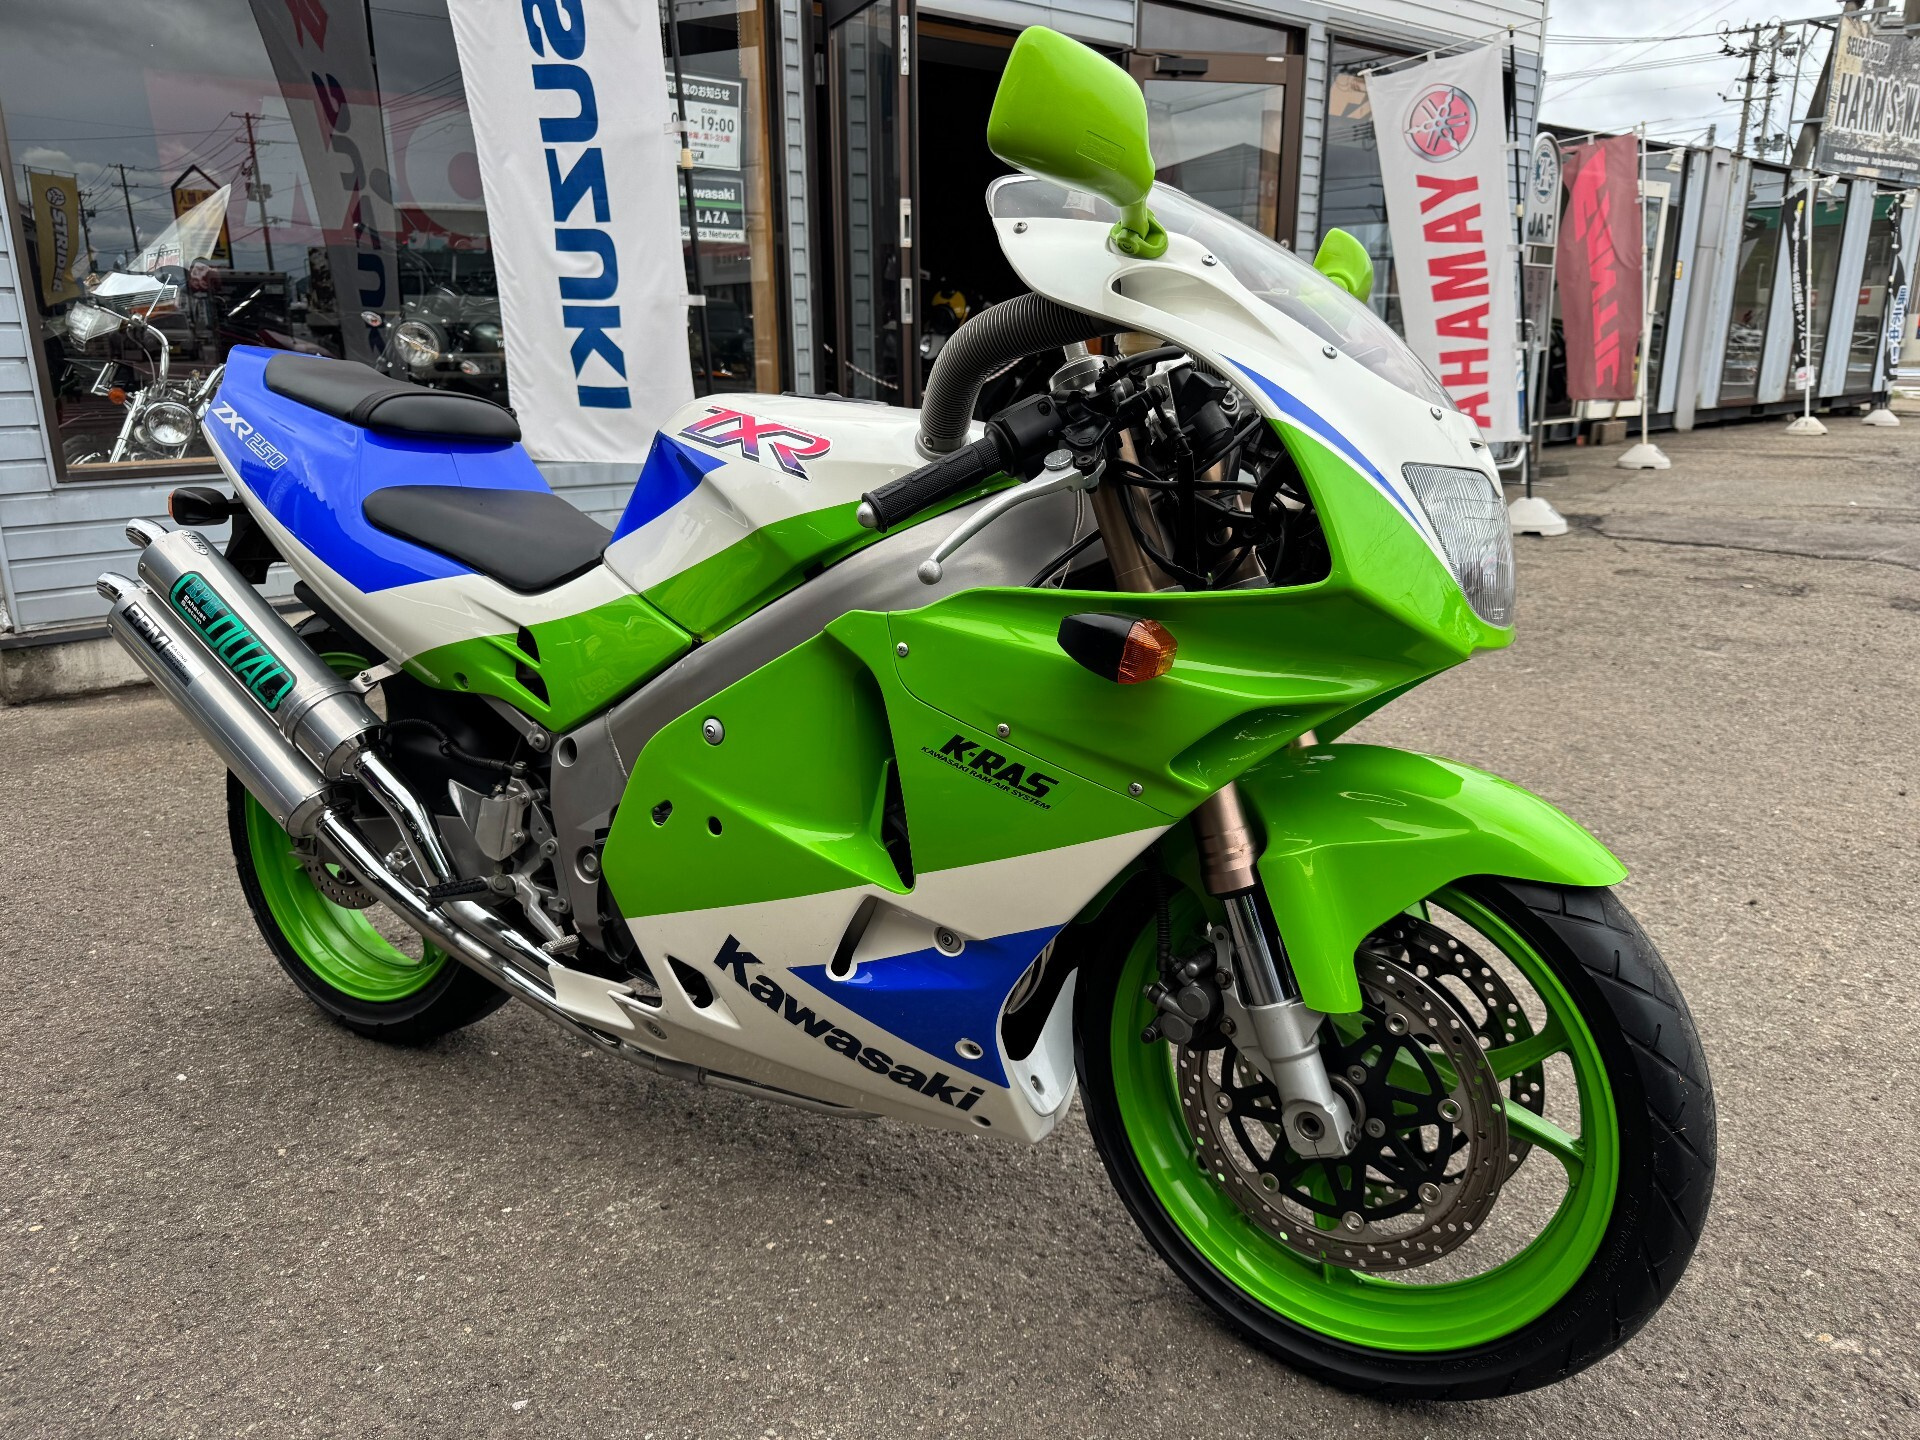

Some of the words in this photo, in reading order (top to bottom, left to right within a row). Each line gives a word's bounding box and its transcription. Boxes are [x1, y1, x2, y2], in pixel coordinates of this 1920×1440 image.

[696, 209, 730, 225] LAZA
[1528, 212, 1553, 239] JAF
[212, 401, 254, 441] ZXR
[245, 432, 288, 470] 250
[677, 405, 832, 481] ZXR
[180, 600, 202, 625] System
[183, 594, 206, 624] Exhaust
[185, 578, 216, 619] RPM
[124, 603, 170, 653] RPM
[921, 746, 969, 773] KAWASAKI
[969, 769, 992, 784] RAM
[993, 781, 1011, 792] AIR
[1011, 789, 1052, 810] SYSTEM
[713, 934, 986, 1112] Kawasaki
